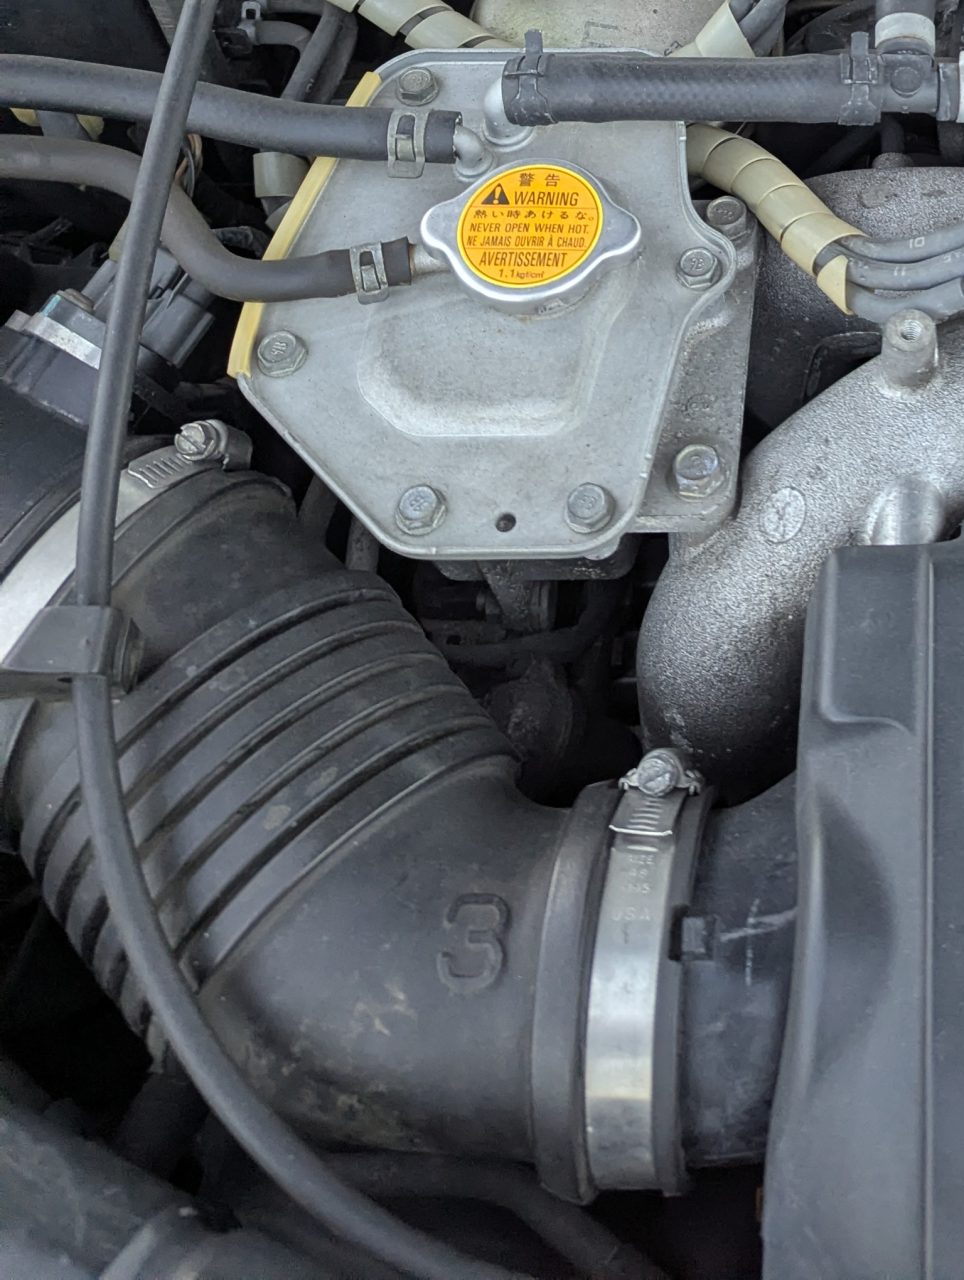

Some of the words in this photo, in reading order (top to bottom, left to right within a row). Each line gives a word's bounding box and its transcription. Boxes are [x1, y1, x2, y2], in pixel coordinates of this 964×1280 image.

[519, 172, 560, 187] 警告
[514, 191, 579, 206] WARNING
[470, 223, 500, 233] NEVER
[505, 223, 530, 233] OPEN
[534, 223, 564, 233] WHEN
[568, 224, 589, 234] HOT.
[467, 236, 477, 247] NE
[480, 236, 511, 247] JAMAIS
[515, 236, 544, 247] OUVRIR
[547, 234, 553, 247] À
[479, 251, 568, 267] AVERTISSEMENT
[437, 892, 512, 992] 3
